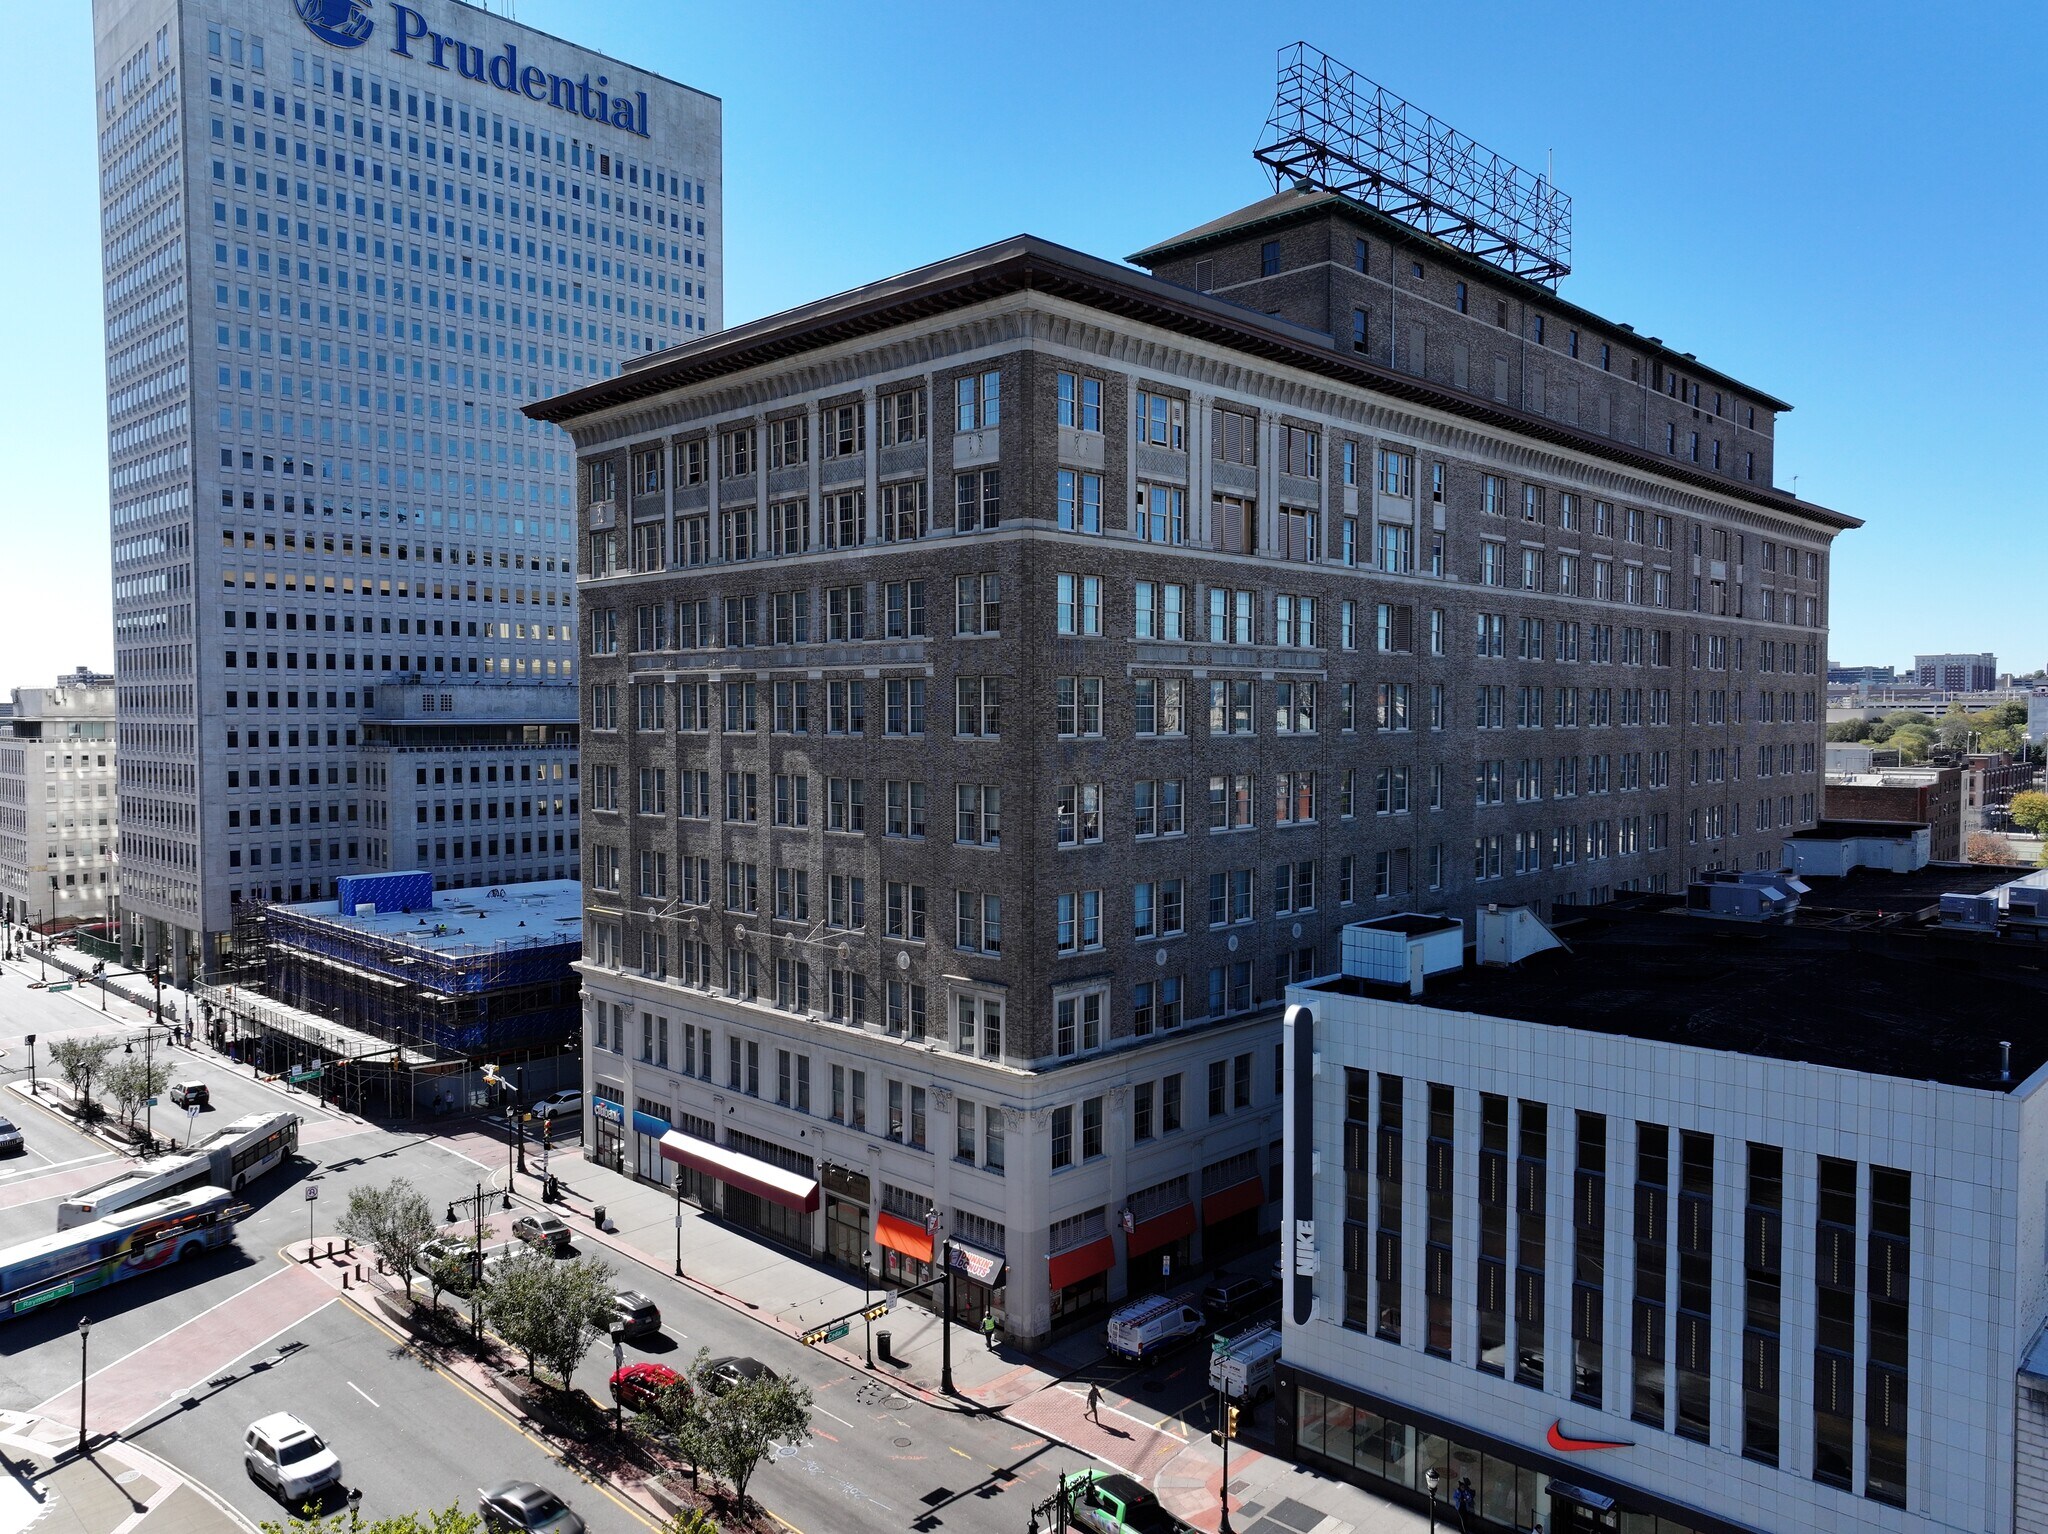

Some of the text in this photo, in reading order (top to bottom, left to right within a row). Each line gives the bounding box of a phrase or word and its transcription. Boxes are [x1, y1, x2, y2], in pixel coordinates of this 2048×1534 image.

[390, 2, 651, 139] Prudential
[1296, 1219, 1314, 1277] NIKE
[956, 1259, 990, 1277] DONUTS
[23, 1292, 55, 1308] Raymond
[828, 1329, 843, 1340] Cedar
